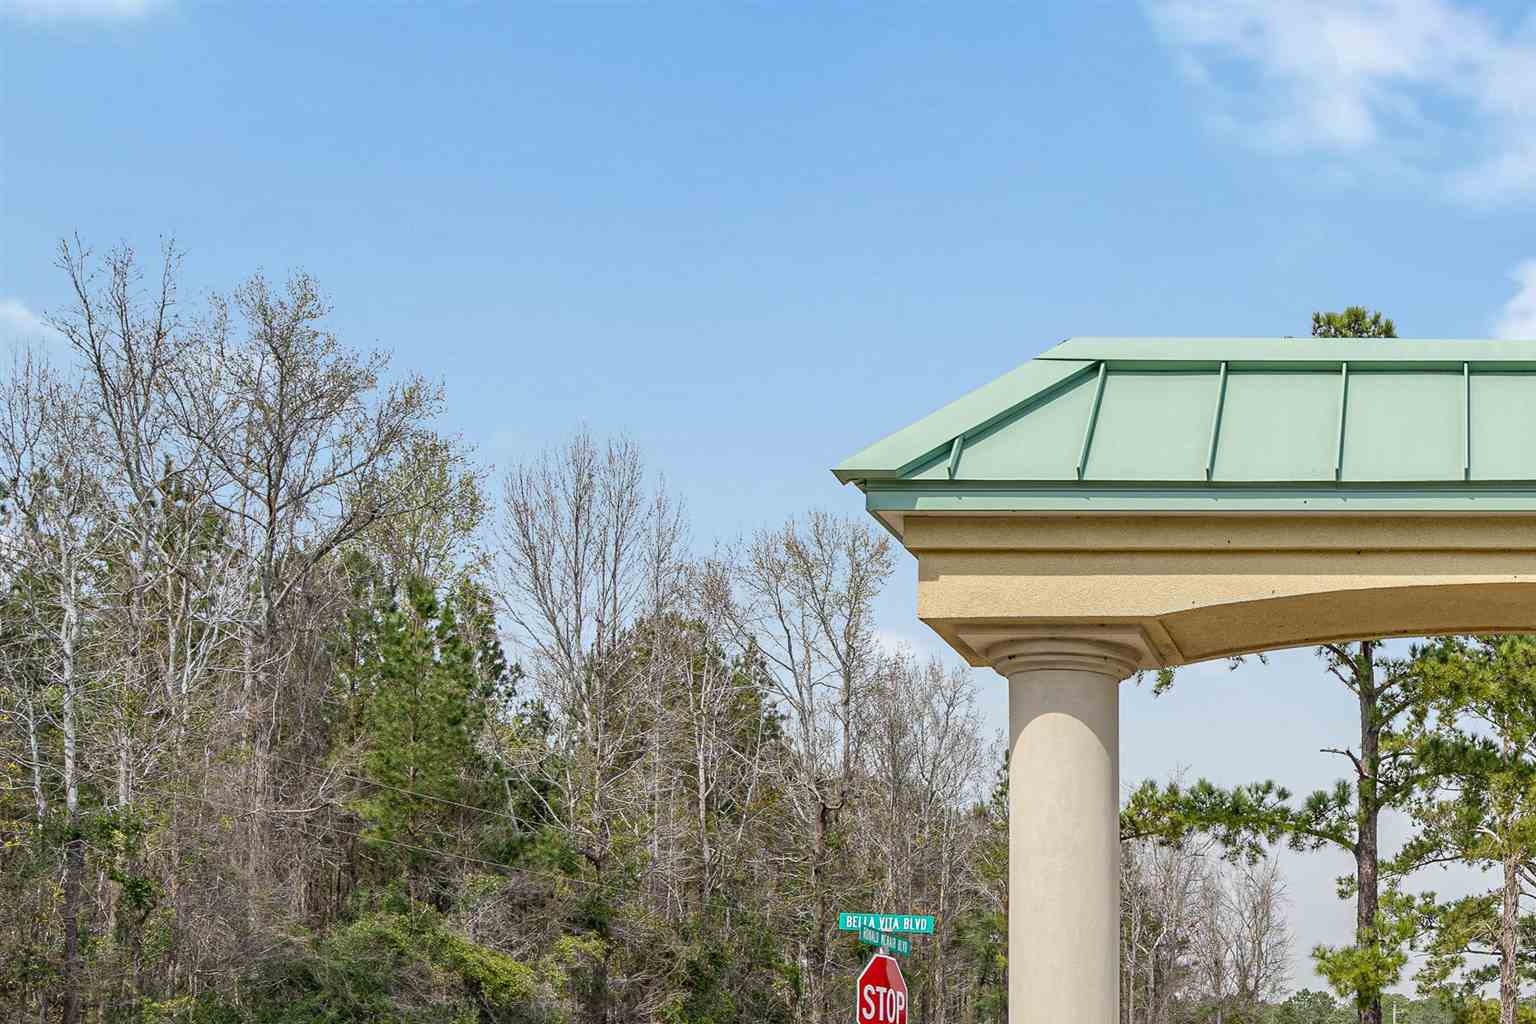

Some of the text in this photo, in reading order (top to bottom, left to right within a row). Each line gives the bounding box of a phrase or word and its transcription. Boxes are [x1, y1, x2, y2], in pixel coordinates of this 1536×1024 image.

[846, 915, 927, 930] BELLA VITA BLVD
[862, 984, 905, 1024] STOP
